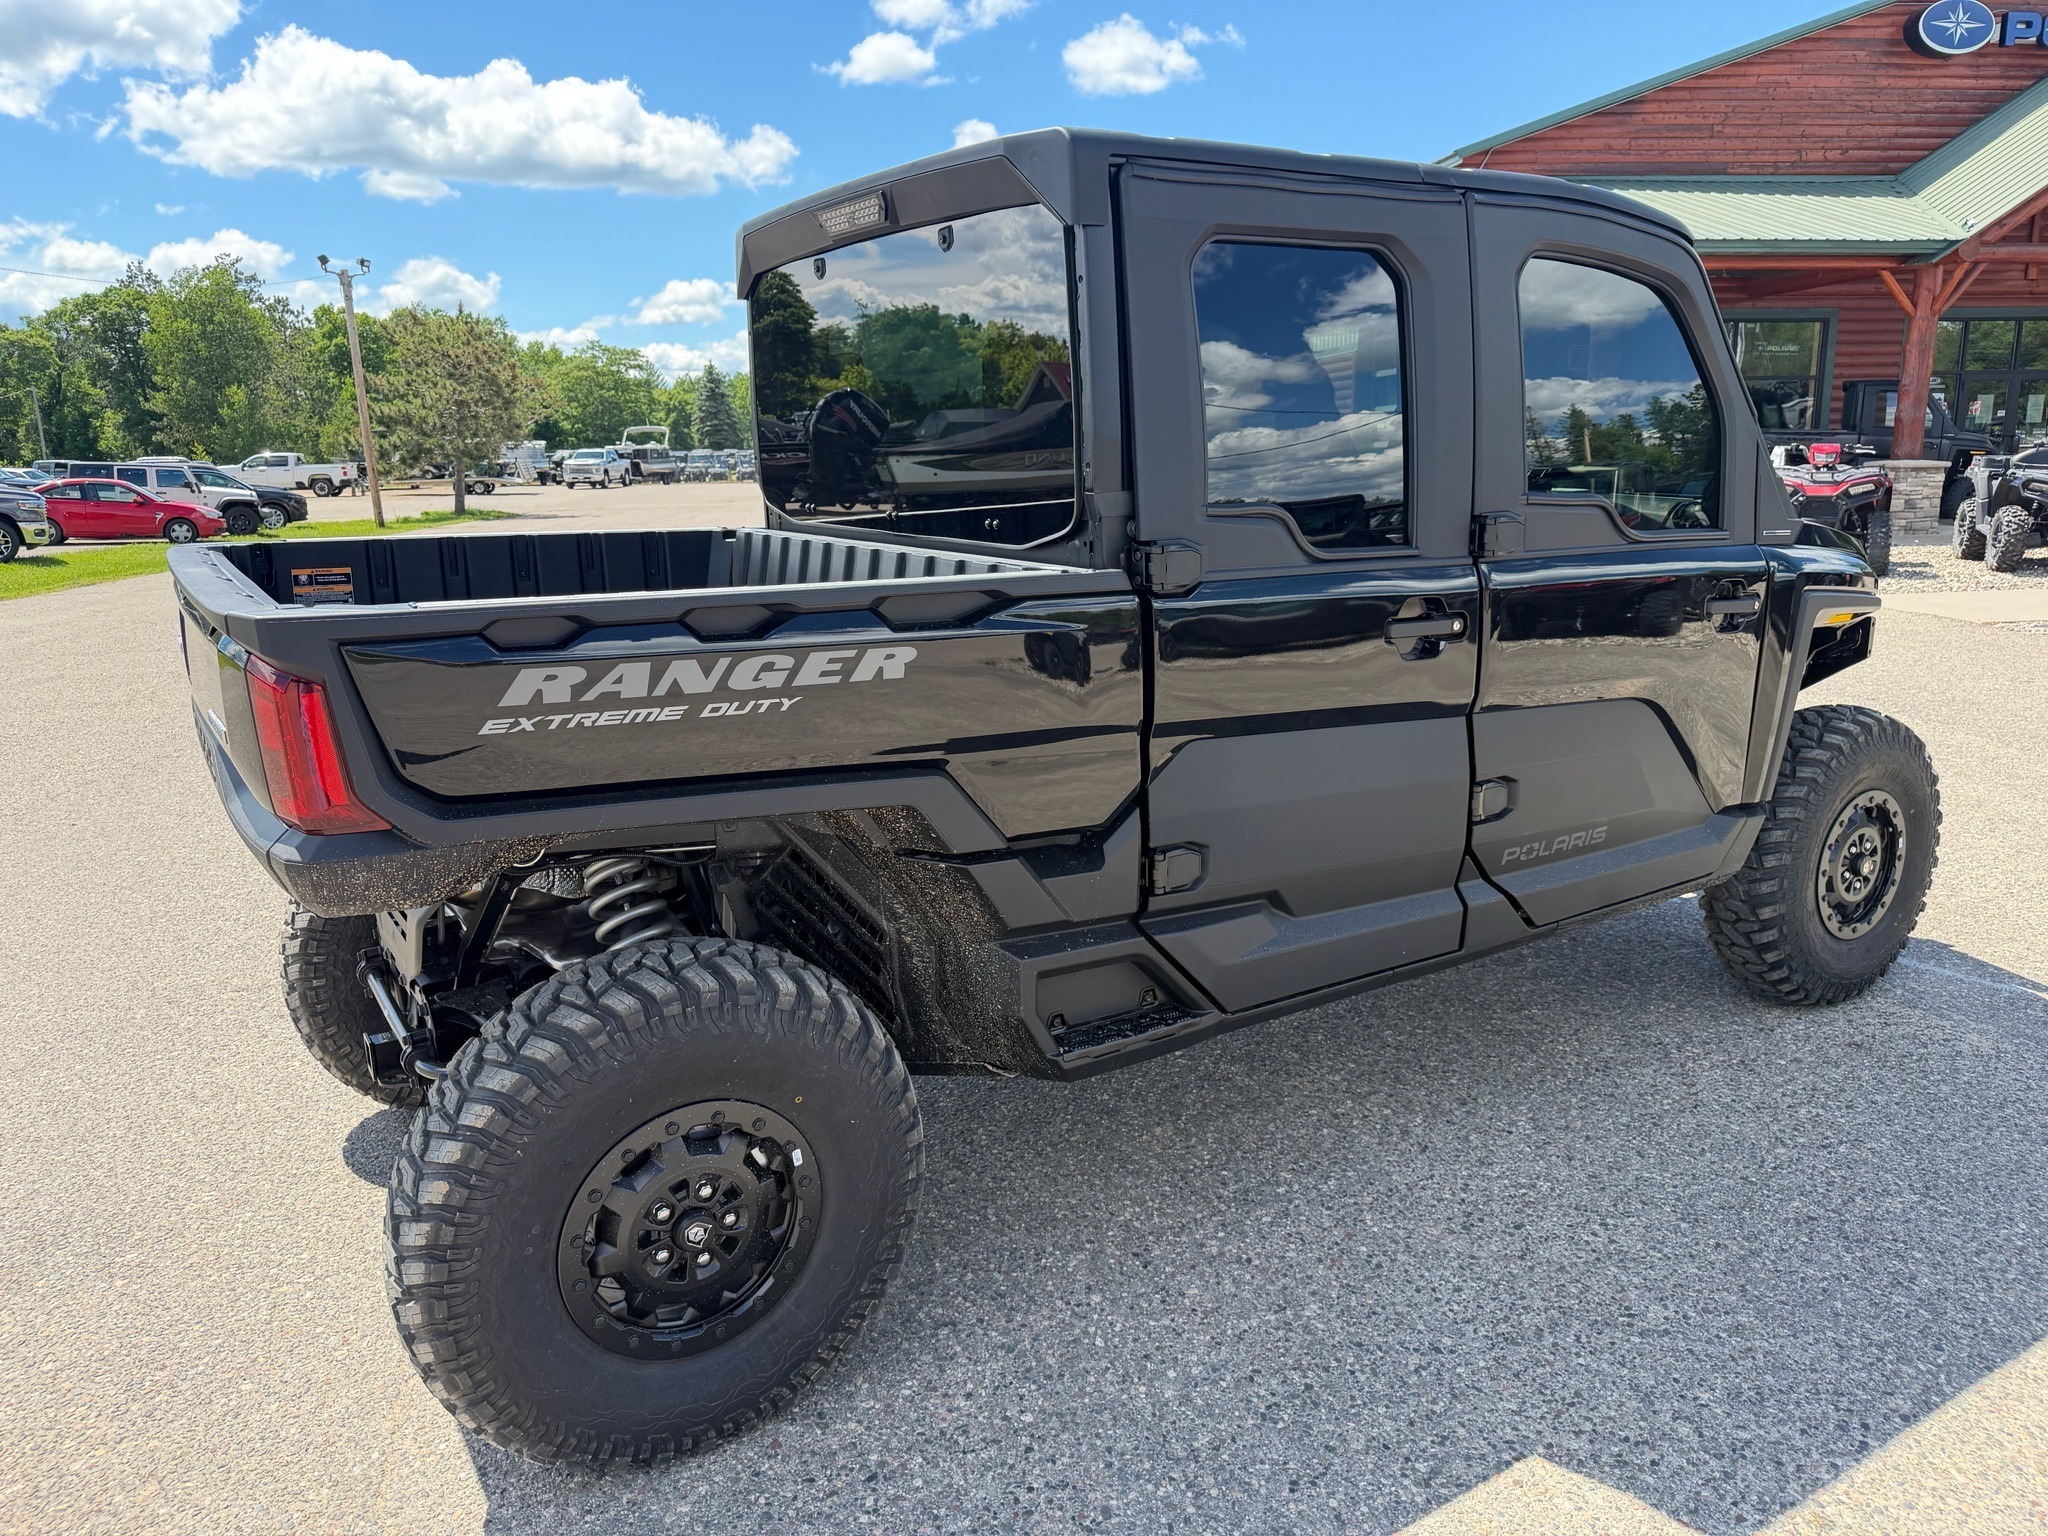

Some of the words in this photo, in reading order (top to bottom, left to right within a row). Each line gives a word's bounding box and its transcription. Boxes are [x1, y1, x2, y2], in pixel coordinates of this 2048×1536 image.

[2003, 11, 2048, 46] P
[498, 646, 918, 707] RANGER
[477, 705, 690, 735] EXTREME
[699, 697, 803, 718] DUTY
[1501, 826, 1608, 866] POLARIS
